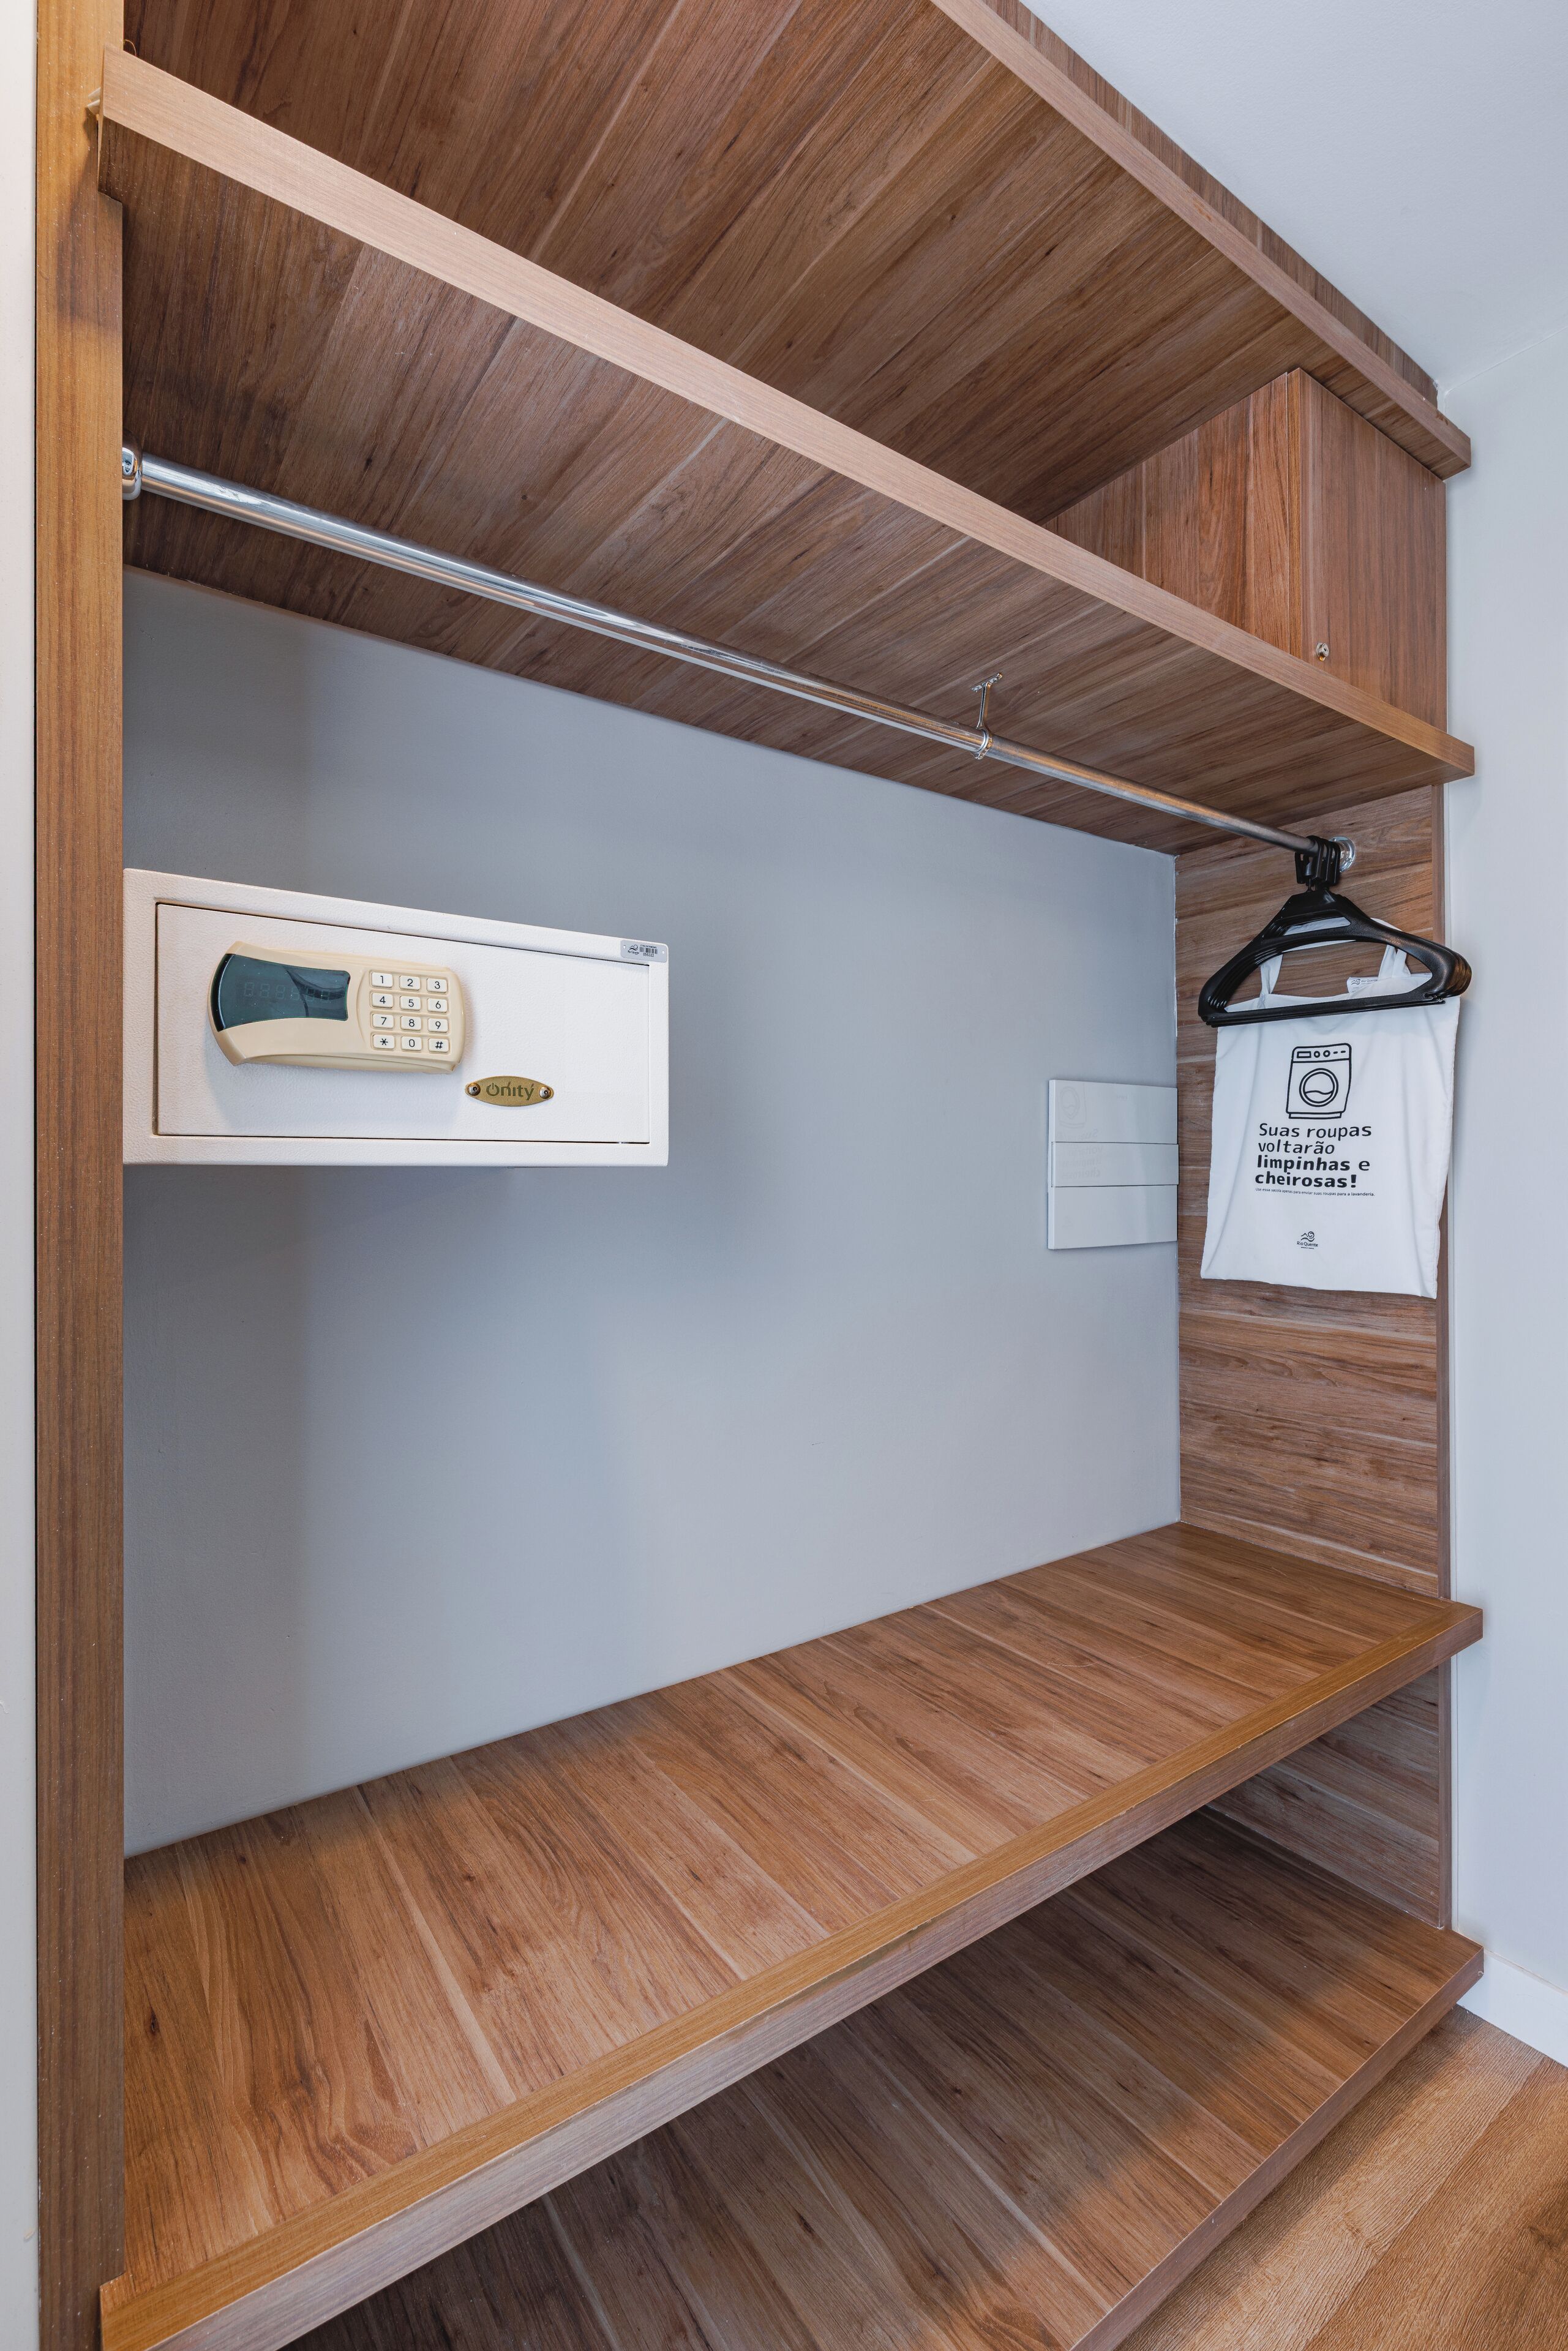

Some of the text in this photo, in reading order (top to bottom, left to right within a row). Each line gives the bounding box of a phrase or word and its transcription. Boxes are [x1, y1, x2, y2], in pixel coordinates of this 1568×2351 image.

[407, 978, 413, 987] 2
[486, 1081, 534, 1100] Onity
[1259, 1123, 1371, 1141] Suas roupas
[1258, 1139, 1335, 1154] voltarão
[1258, 1155, 1370, 1172] limpinhas e
[1255, 1171, 1357, 1188] cheirosas!
